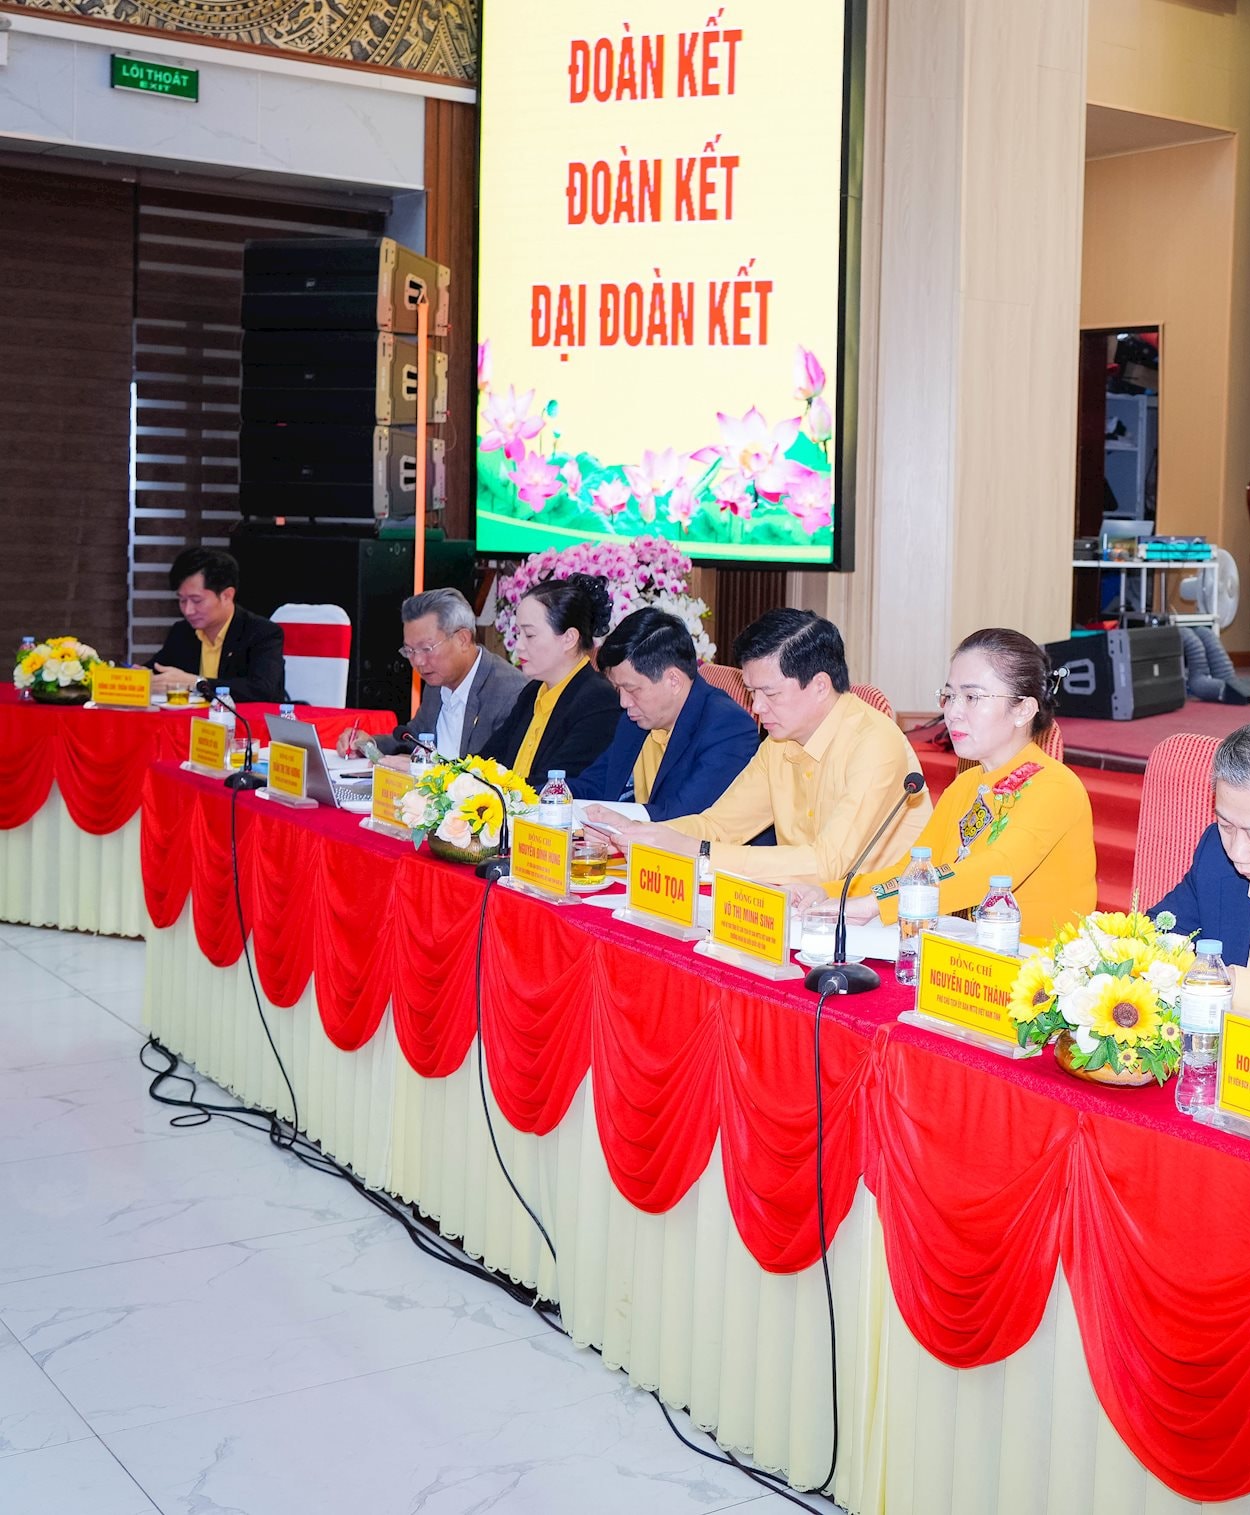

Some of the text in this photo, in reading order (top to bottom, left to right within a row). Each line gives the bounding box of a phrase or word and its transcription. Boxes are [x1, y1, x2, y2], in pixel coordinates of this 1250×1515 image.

[568, 8, 742, 103] ĐOÀN KẾT
[139, 80, 170, 91] EXIT
[566, 134, 739, 225] ĐOÀN KẾT
[531, 258, 772, 361] ĐẠI ĐOÀN KẾT
[640, 865, 685, 904] CHỦ TỌA
[743, 908, 758, 925] MINH
[760, 914, 774, 930] SINH
[950, 954, 992, 977] ĐỒNG CHÍ
[930, 969, 962, 993] NGUYỄN
[964, 978, 981, 999] ĐỨC
